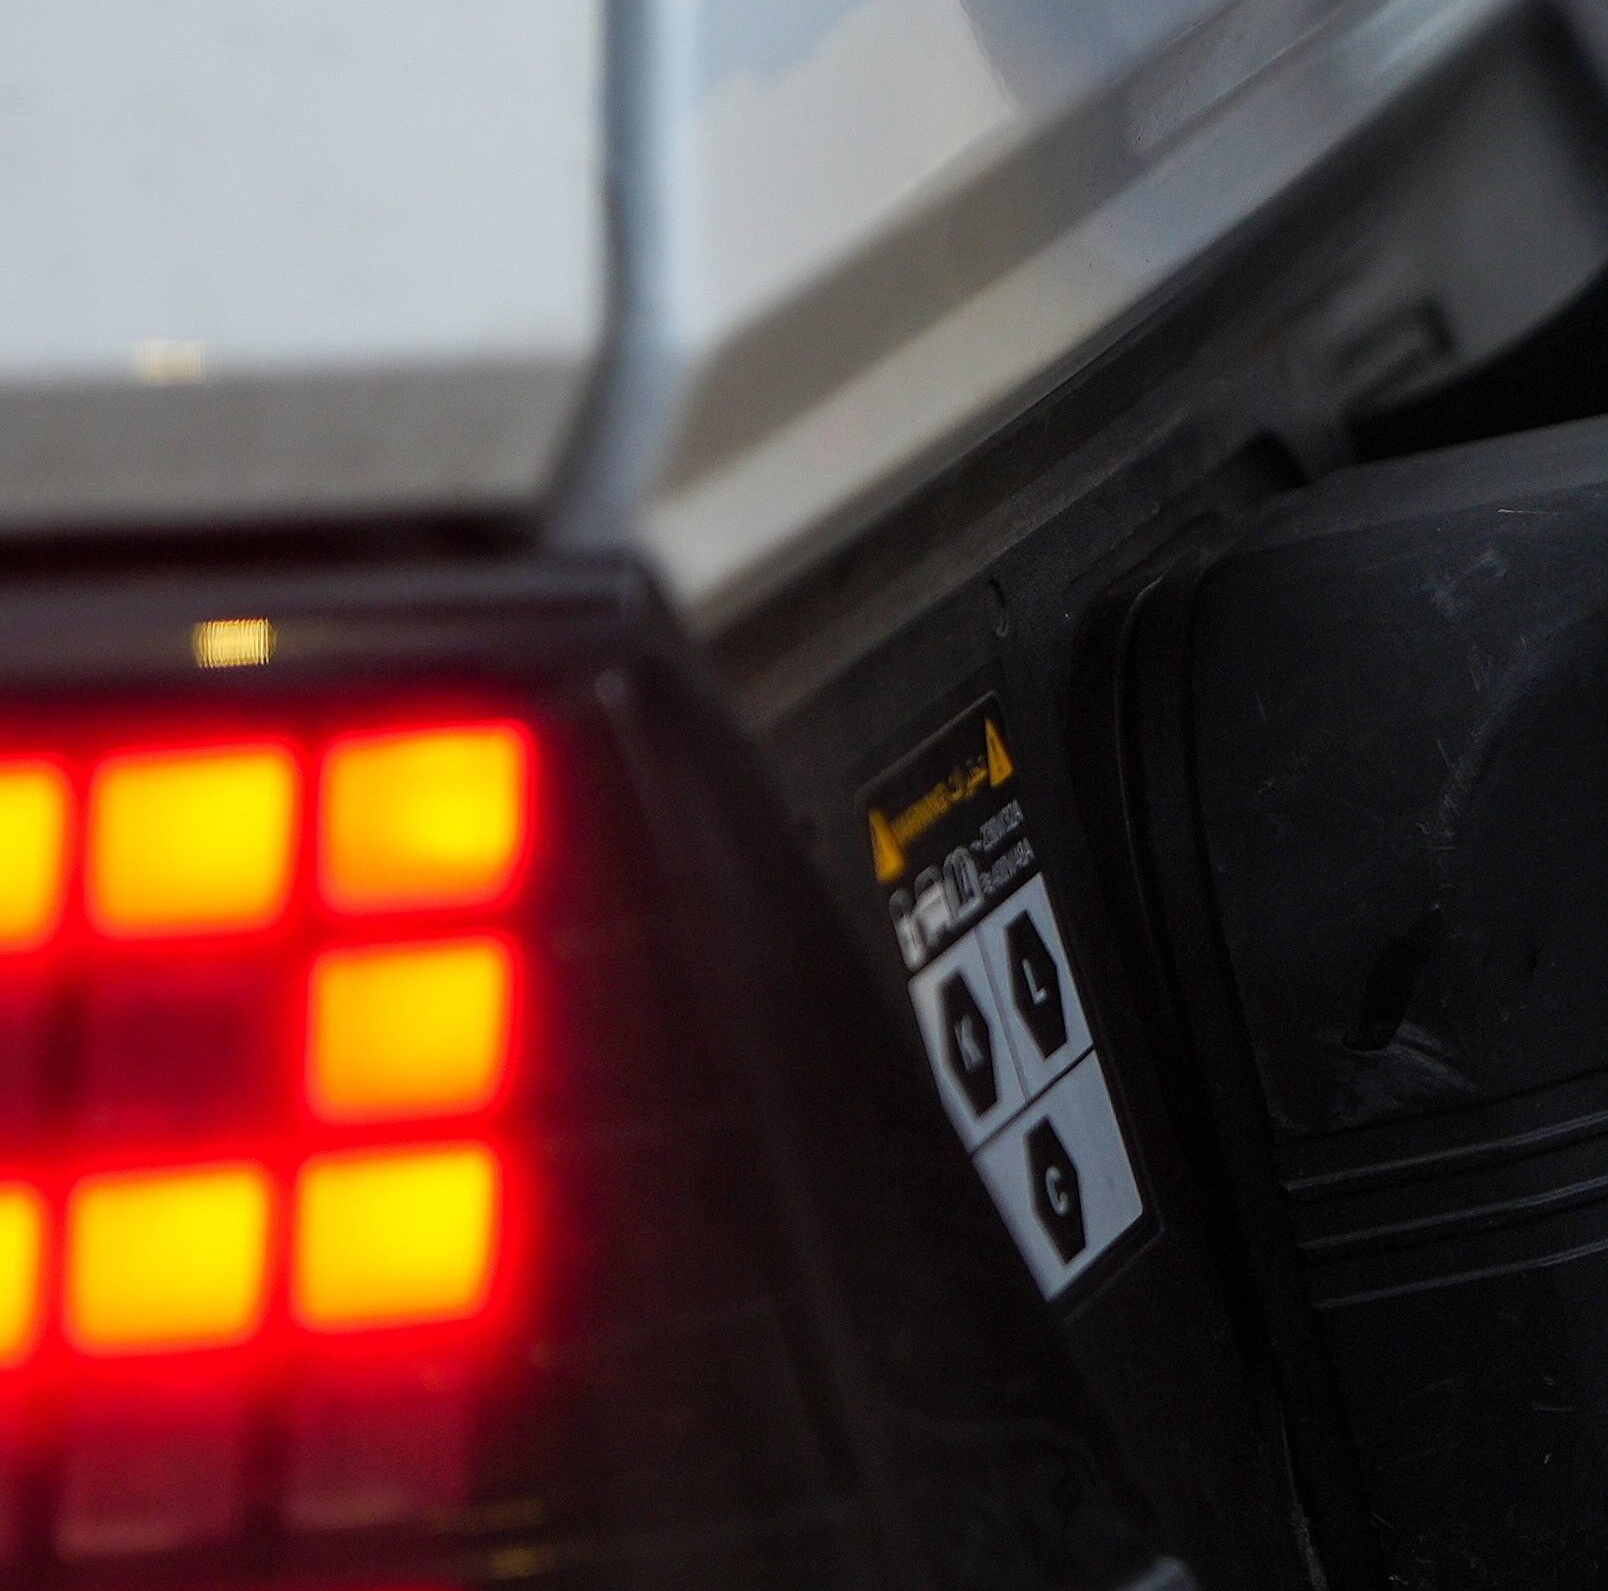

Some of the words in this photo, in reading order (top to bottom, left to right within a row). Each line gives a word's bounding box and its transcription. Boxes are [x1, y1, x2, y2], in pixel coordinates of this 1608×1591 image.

[1021, 958, 1047, 1005] L
[954, 1015, 983, 1072] K
[1045, 1165, 1070, 1217] C
